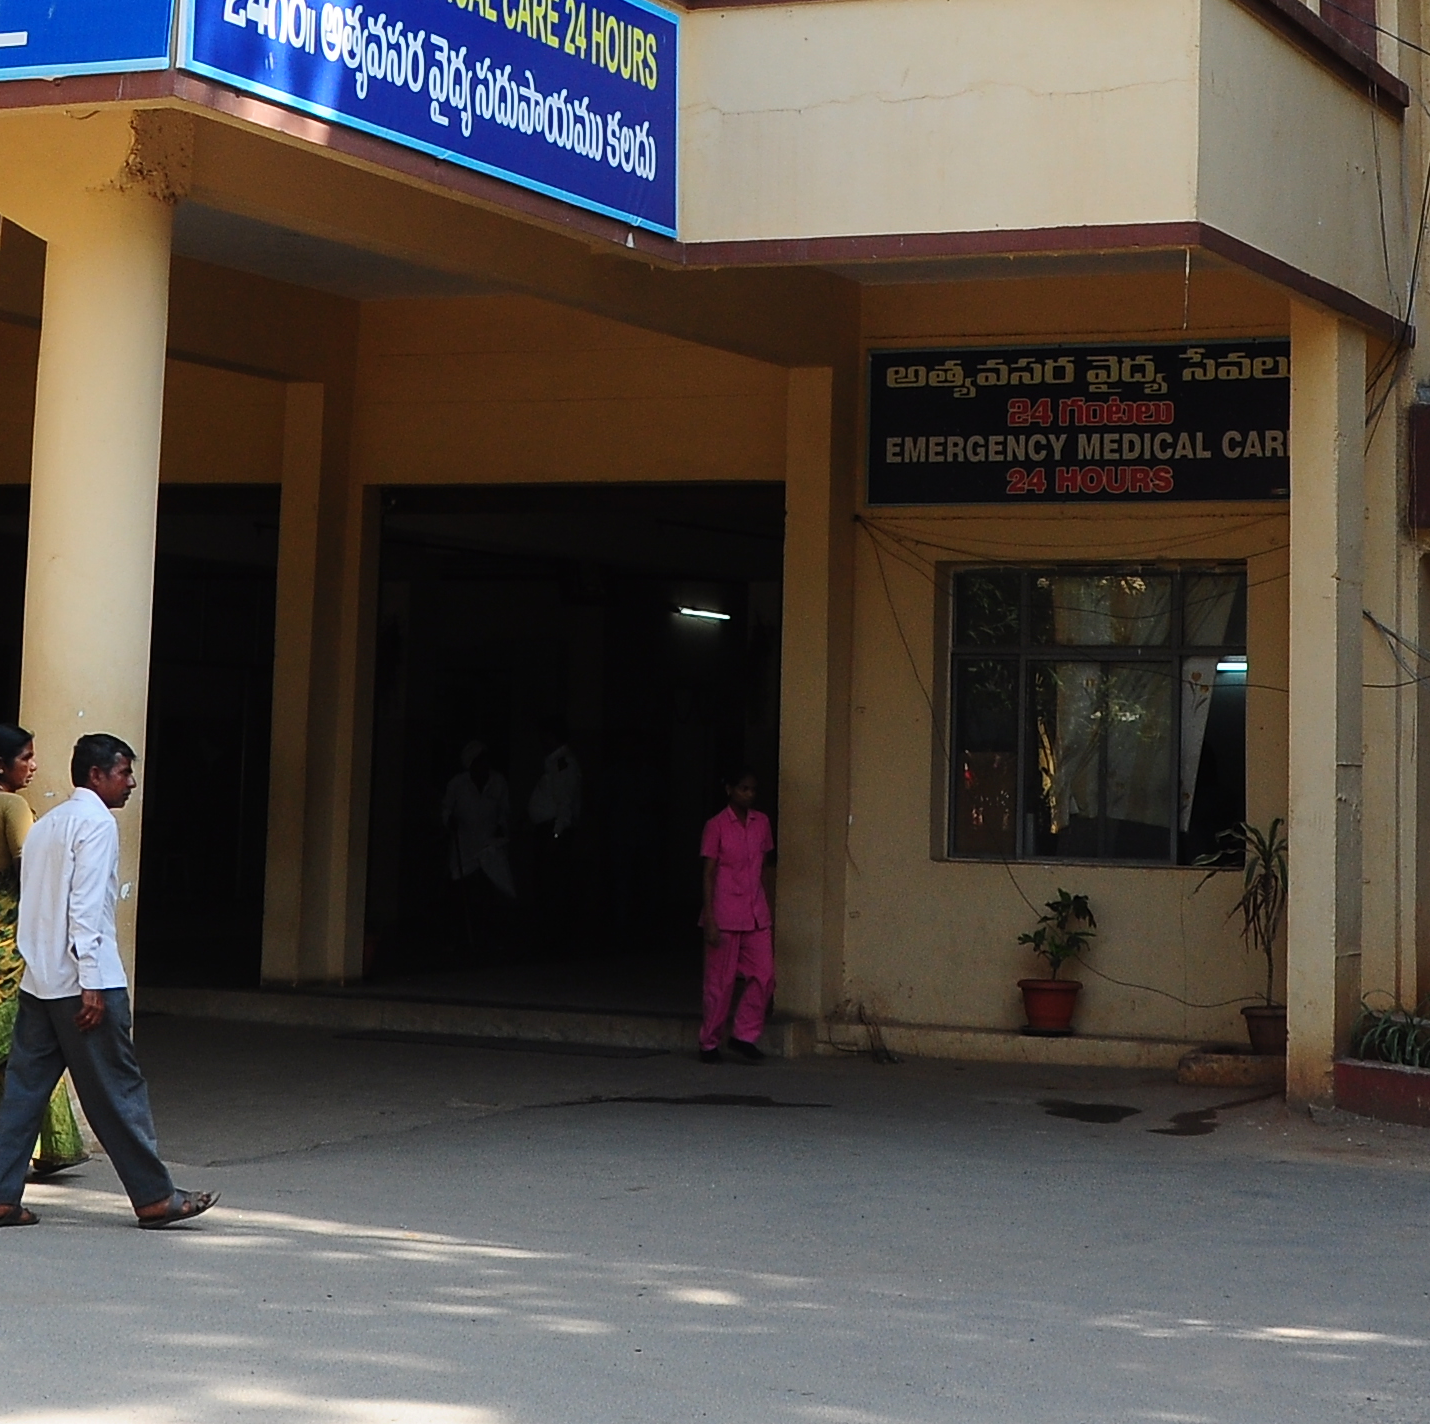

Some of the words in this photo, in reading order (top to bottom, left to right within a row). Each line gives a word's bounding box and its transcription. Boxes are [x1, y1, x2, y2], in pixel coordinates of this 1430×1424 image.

[591, 7, 657, 90] HOURS
[321, 2, 425, 100] అత్యవసర
[428, 33, 473, 138] వైద్య
[474, 57, 604, 162] సదుపాయము
[606, 111, 657, 182] కలదు
[1086, 354, 1169, 395] వైద్య
[1179, 347, 1291, 382] సేవల
[1007, 397, 1053, 426] 24
[1058, 395, 1175, 426] గంటలు
[886, 434, 1068, 463] EMERGENCY
[1077, 431, 1212, 461] MEDICAL
[1222, 430, 1291, 459] CAR
[1006, 467, 1047, 494] 24
[1055, 465, 1175, 494] HOURS
